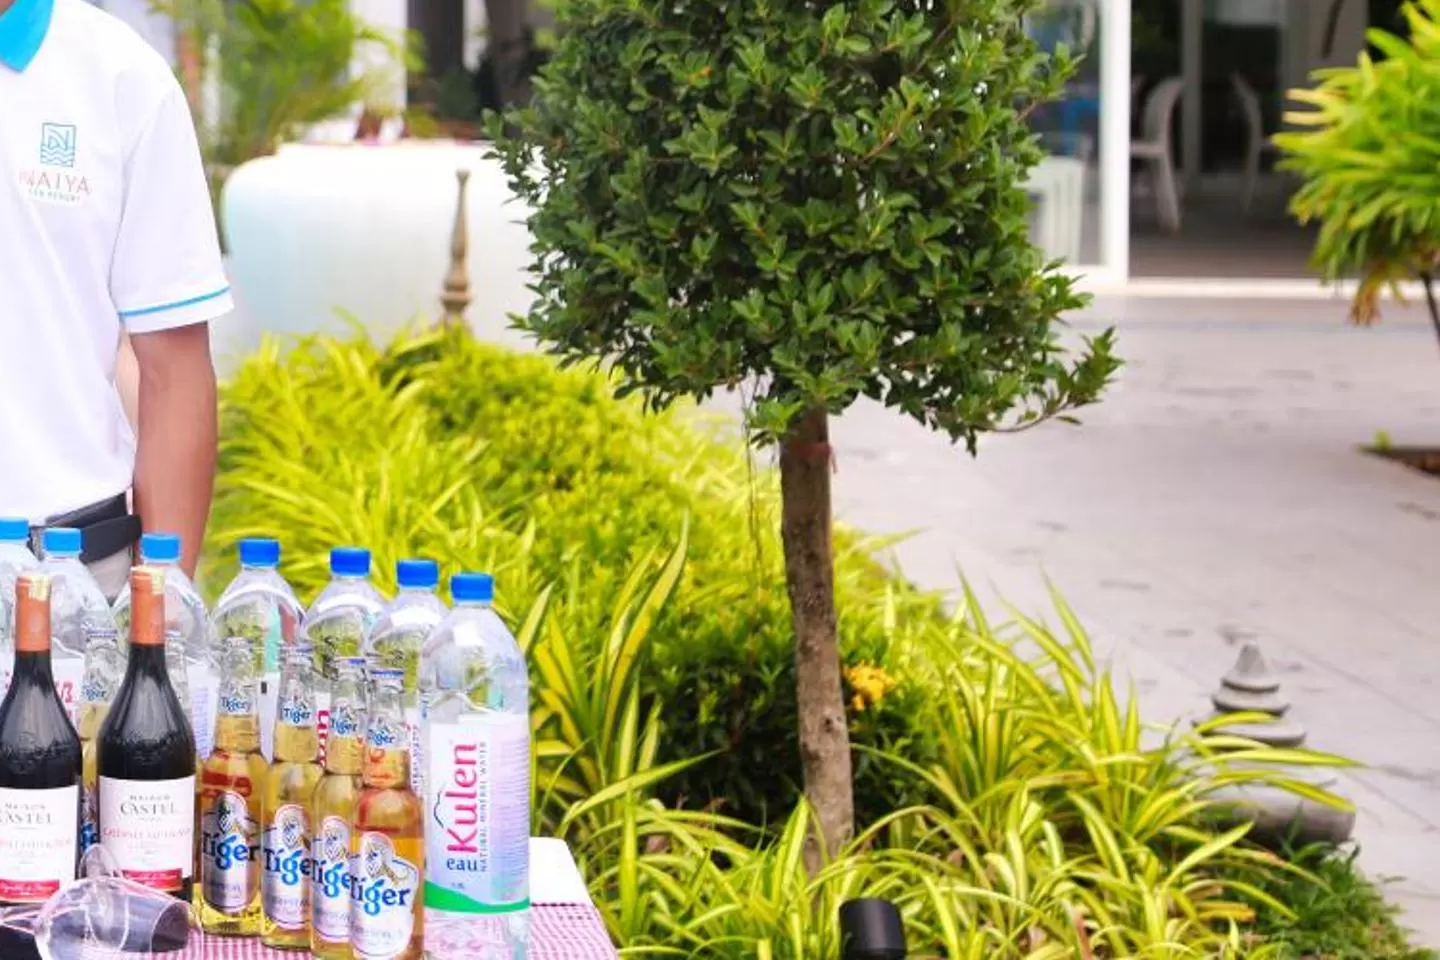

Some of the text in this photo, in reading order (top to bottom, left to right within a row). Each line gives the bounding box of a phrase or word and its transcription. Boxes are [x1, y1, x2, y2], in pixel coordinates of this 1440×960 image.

[19, 170, 91, 195] NAIYA
[283, 707, 311, 724] Tiger
[368, 726, 396, 746] Tiger
[120, 801, 178, 816] CASTEL
[445, 743, 478, 853] Kulen
[203, 832, 260, 870] Tiger
[263, 847, 311, 885] Tige
[446, 857, 478, 872] eau
[312, 859, 350, 898] Tige
[350, 876, 411, 916] Tiger
